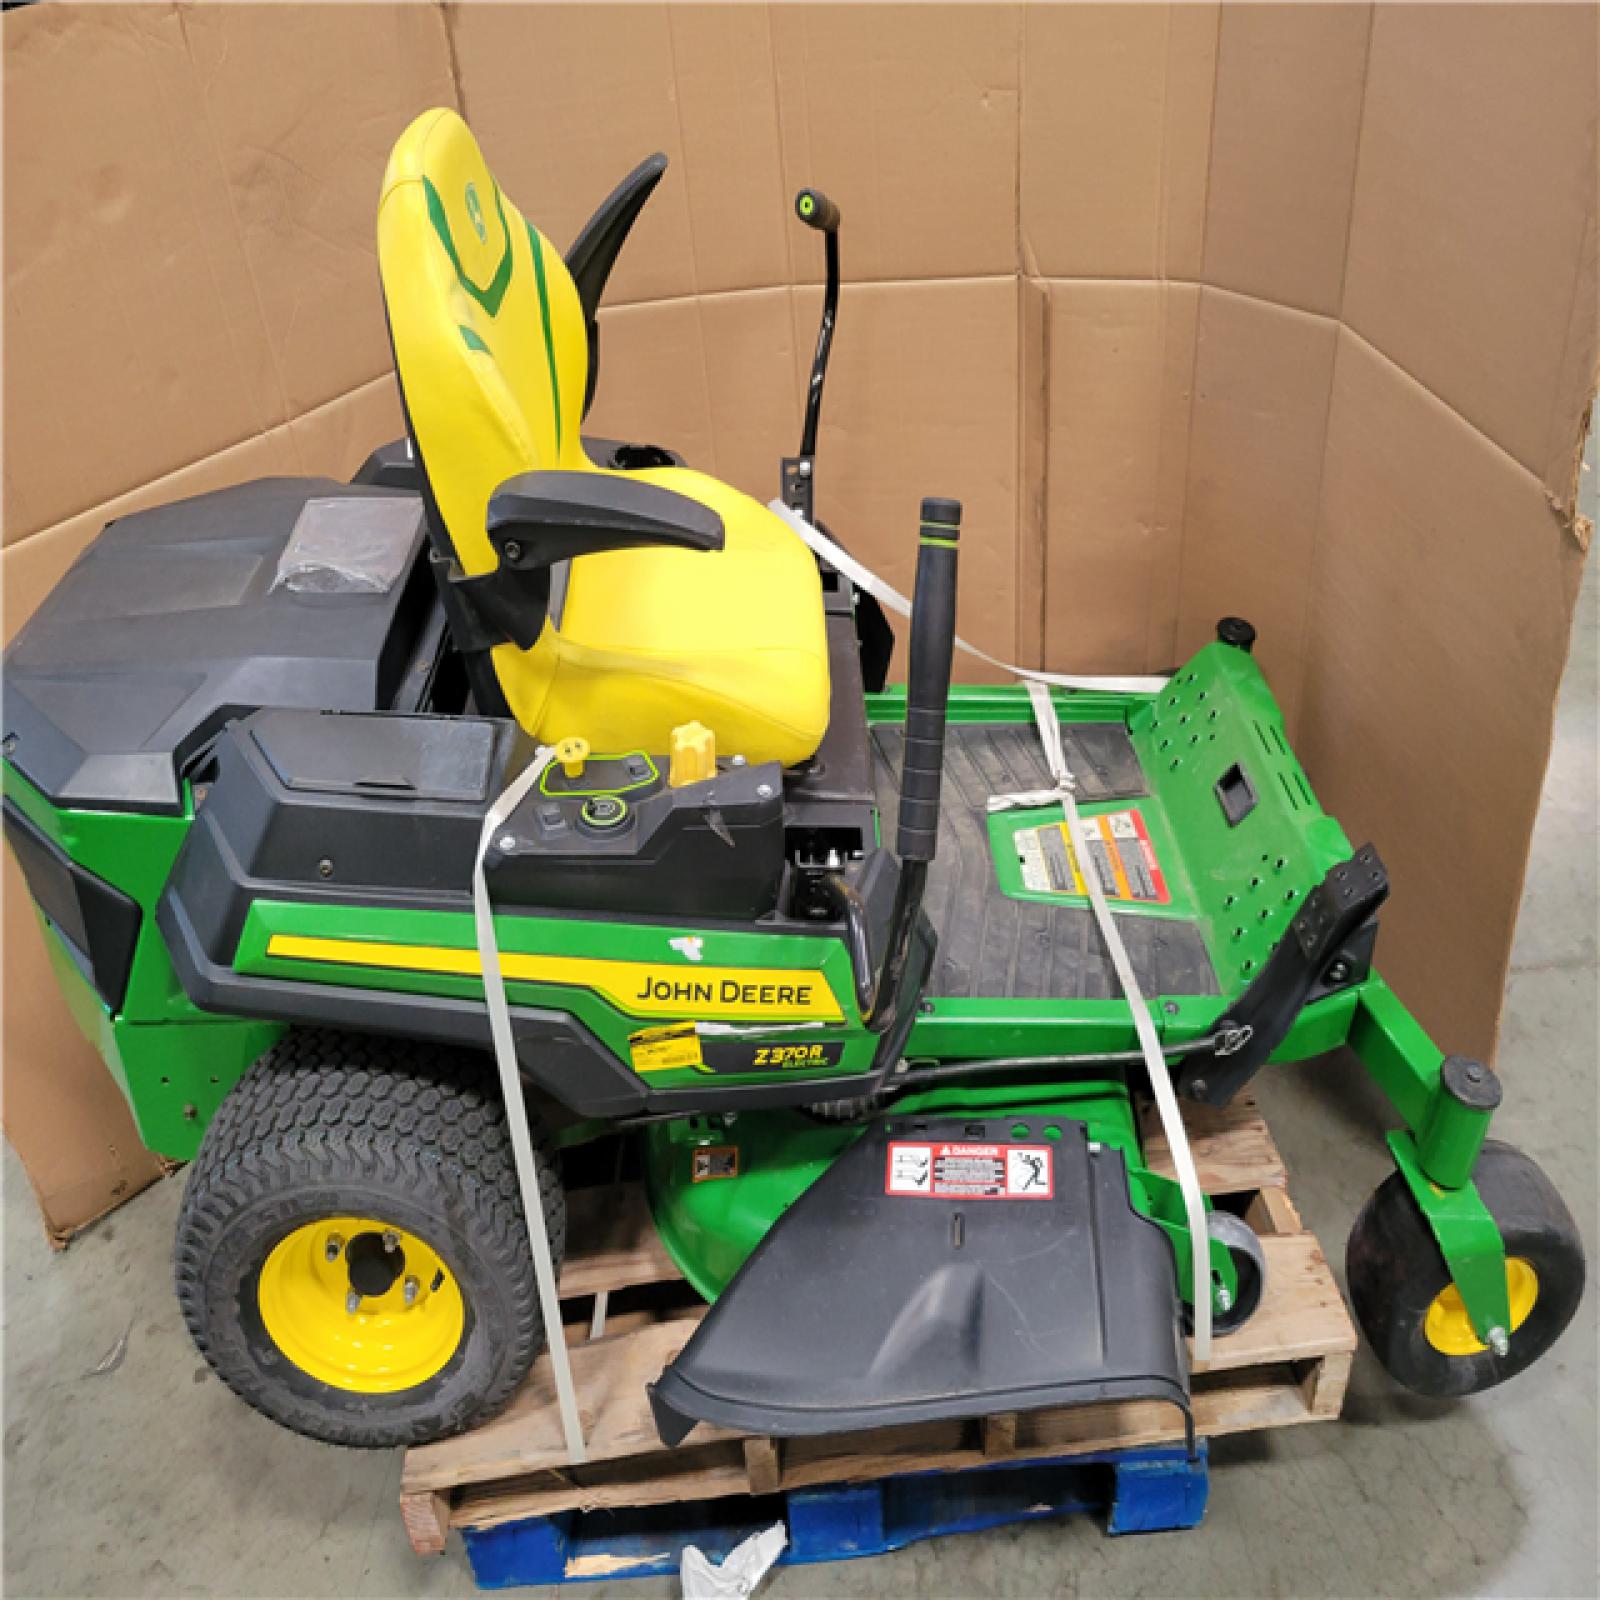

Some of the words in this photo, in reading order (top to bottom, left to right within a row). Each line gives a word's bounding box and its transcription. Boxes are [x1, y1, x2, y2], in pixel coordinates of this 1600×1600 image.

[637, 977, 712, 1002] JOHN
[720, 980, 812, 1005] DEERE
[951, 1145, 999, 1156] DANGER
